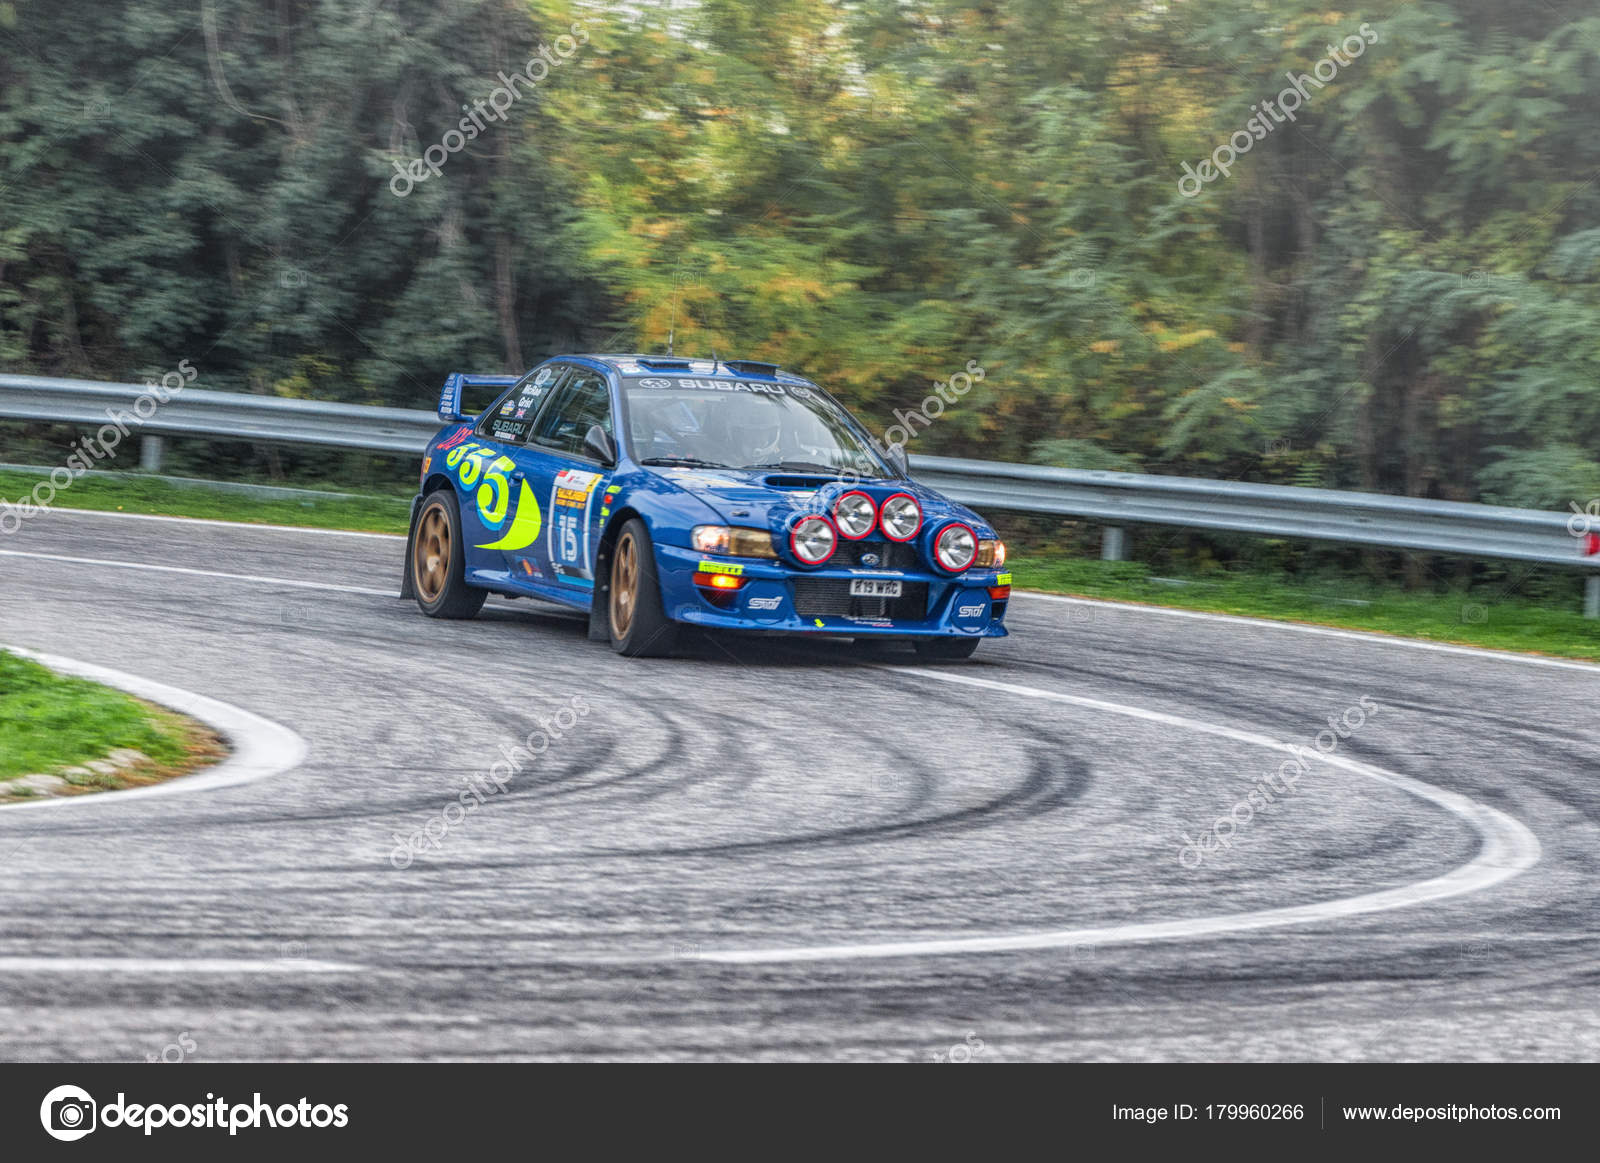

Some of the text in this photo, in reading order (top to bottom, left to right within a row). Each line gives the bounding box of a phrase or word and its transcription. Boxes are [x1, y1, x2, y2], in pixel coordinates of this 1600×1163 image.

[678, 378, 785, 395] SUBARU
[492, 418, 527, 436] SUBARU
[446, 442, 516, 530] 555
[558, 514, 578, 562] 15
[876, 582, 898, 595] WRC
